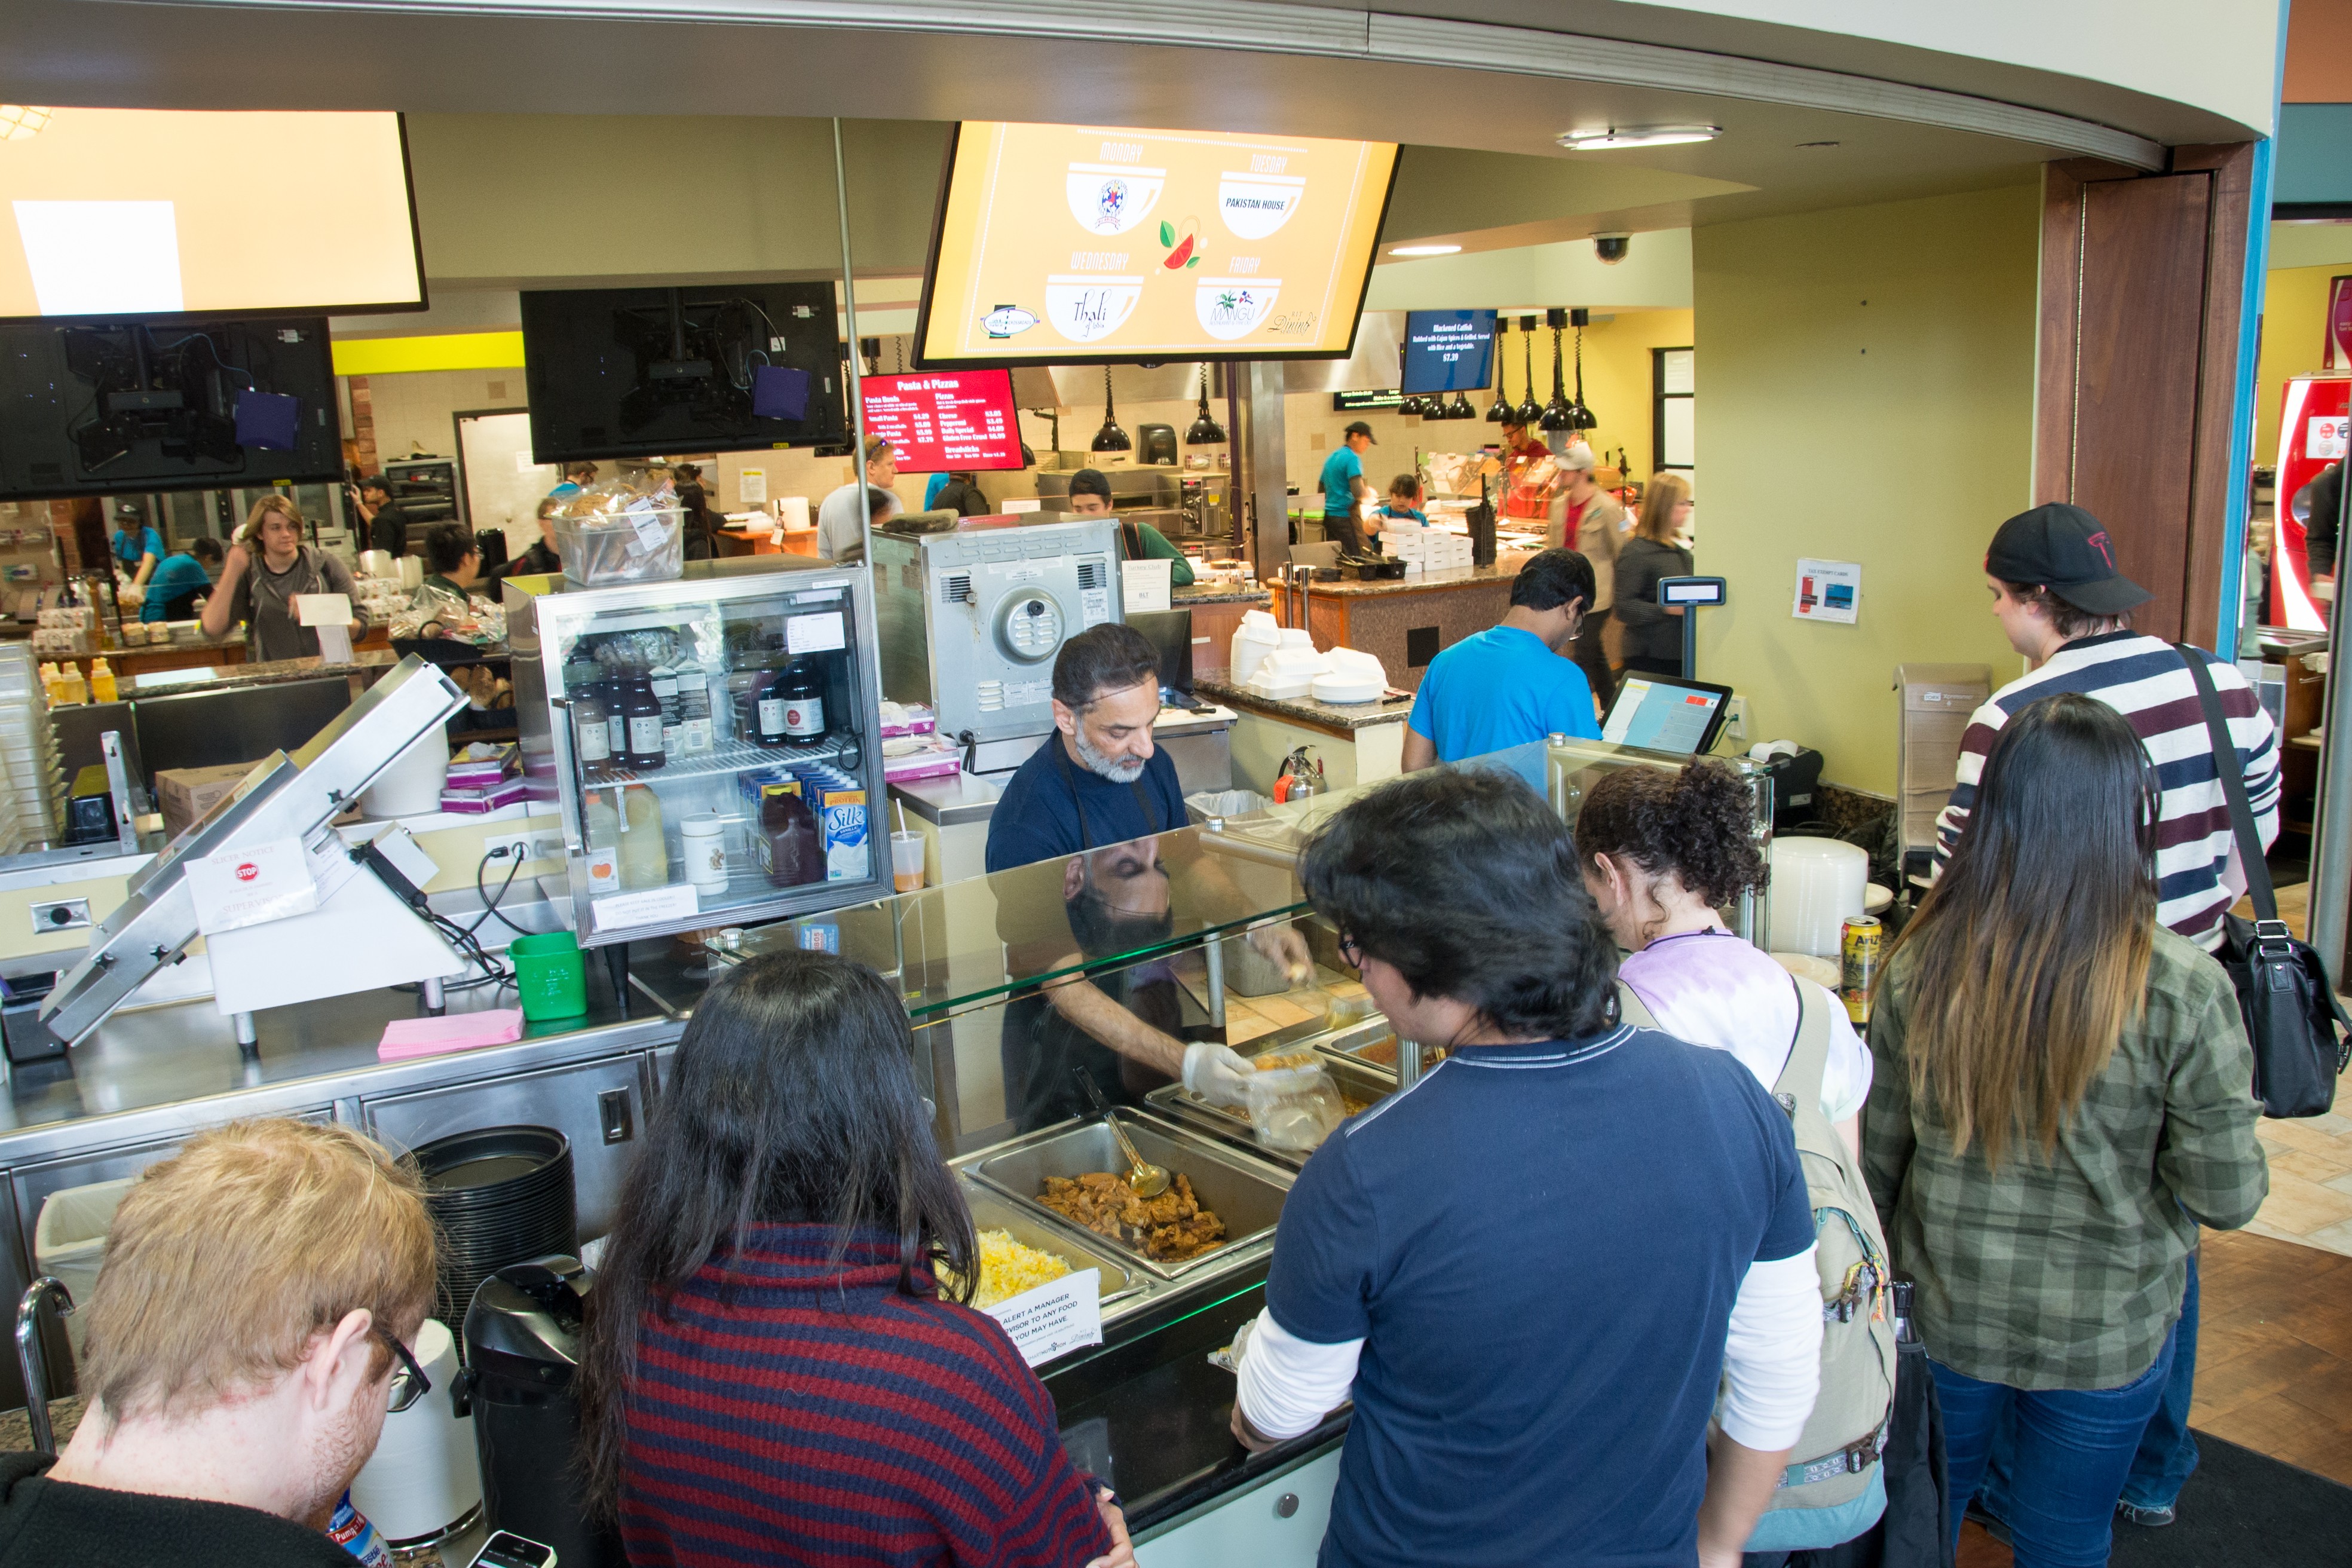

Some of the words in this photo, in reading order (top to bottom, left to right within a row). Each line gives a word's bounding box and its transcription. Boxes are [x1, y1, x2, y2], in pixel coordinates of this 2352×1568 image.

[1100, 142, 1143, 163] MONDAY
[1250, 154, 1288, 173] TUESDAY
[1226, 198, 1261, 209] PAKISTAN
[1262, 200, 1285, 210] HOUSE
[1071, 252, 1129, 270] WEDNESDAY
[1229, 256, 1261, 274] FRIDAY
[1074, 289, 1111, 321] Thali
[1210, 307, 1255, 320] MANGU
[1267, 312, 1316, 335] Dining
[1434, 324, 1456, 332] Blackened
[897, 381, 921, 391] Pasta
[923, 380, 930, 389] &
[932, 379, 958, 388] Pizzas
[829, 807, 862, 830] Silk
[212, 855, 239, 865] SLICER
[243, 846, 275, 858] NOTICE
[237, 866, 257, 877] STOP
[1855, 935, 1881, 947] AriZ
[1003, 1310, 1025, 1325] ALERT
[1034, 1293, 1070, 1312] MANAGER
[1005, 1320, 1029, 1334] RVISOR
[1043, 1309, 1056, 1319] ANY
[1058, 1301, 1077, 1313] FOOD
[1015, 1331, 1030, 1342] YOU
[1031, 1324, 1047, 1335] MAY
